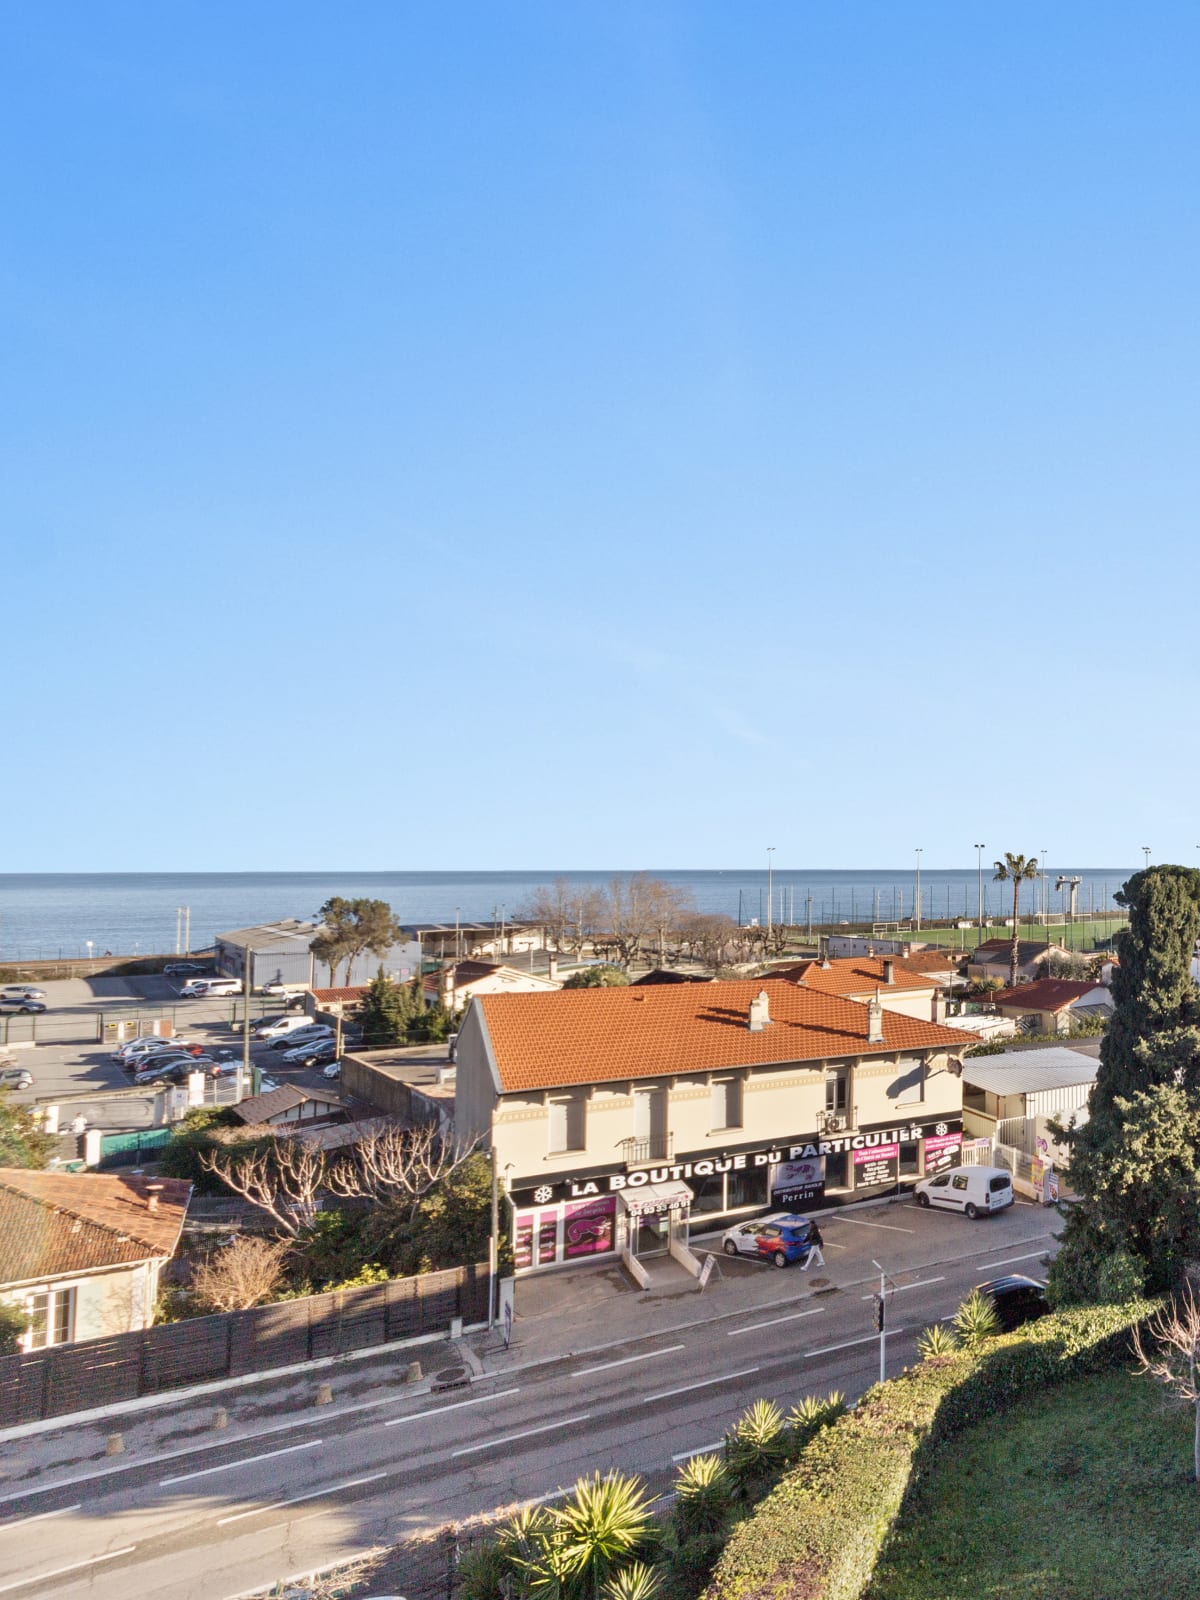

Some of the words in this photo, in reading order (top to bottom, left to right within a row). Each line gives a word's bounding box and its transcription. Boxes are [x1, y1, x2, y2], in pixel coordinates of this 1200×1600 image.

[572, 1182, 598, 1197] LA
[609, 1154, 746, 1191] BOUTIQUE
[754, 1152, 781, 1167] DU
[789, 1127, 923, 1160] PARTICULIER
[782, 1191, 814, 1203] Perrin
[630, 1208, 642, 1217] 04
